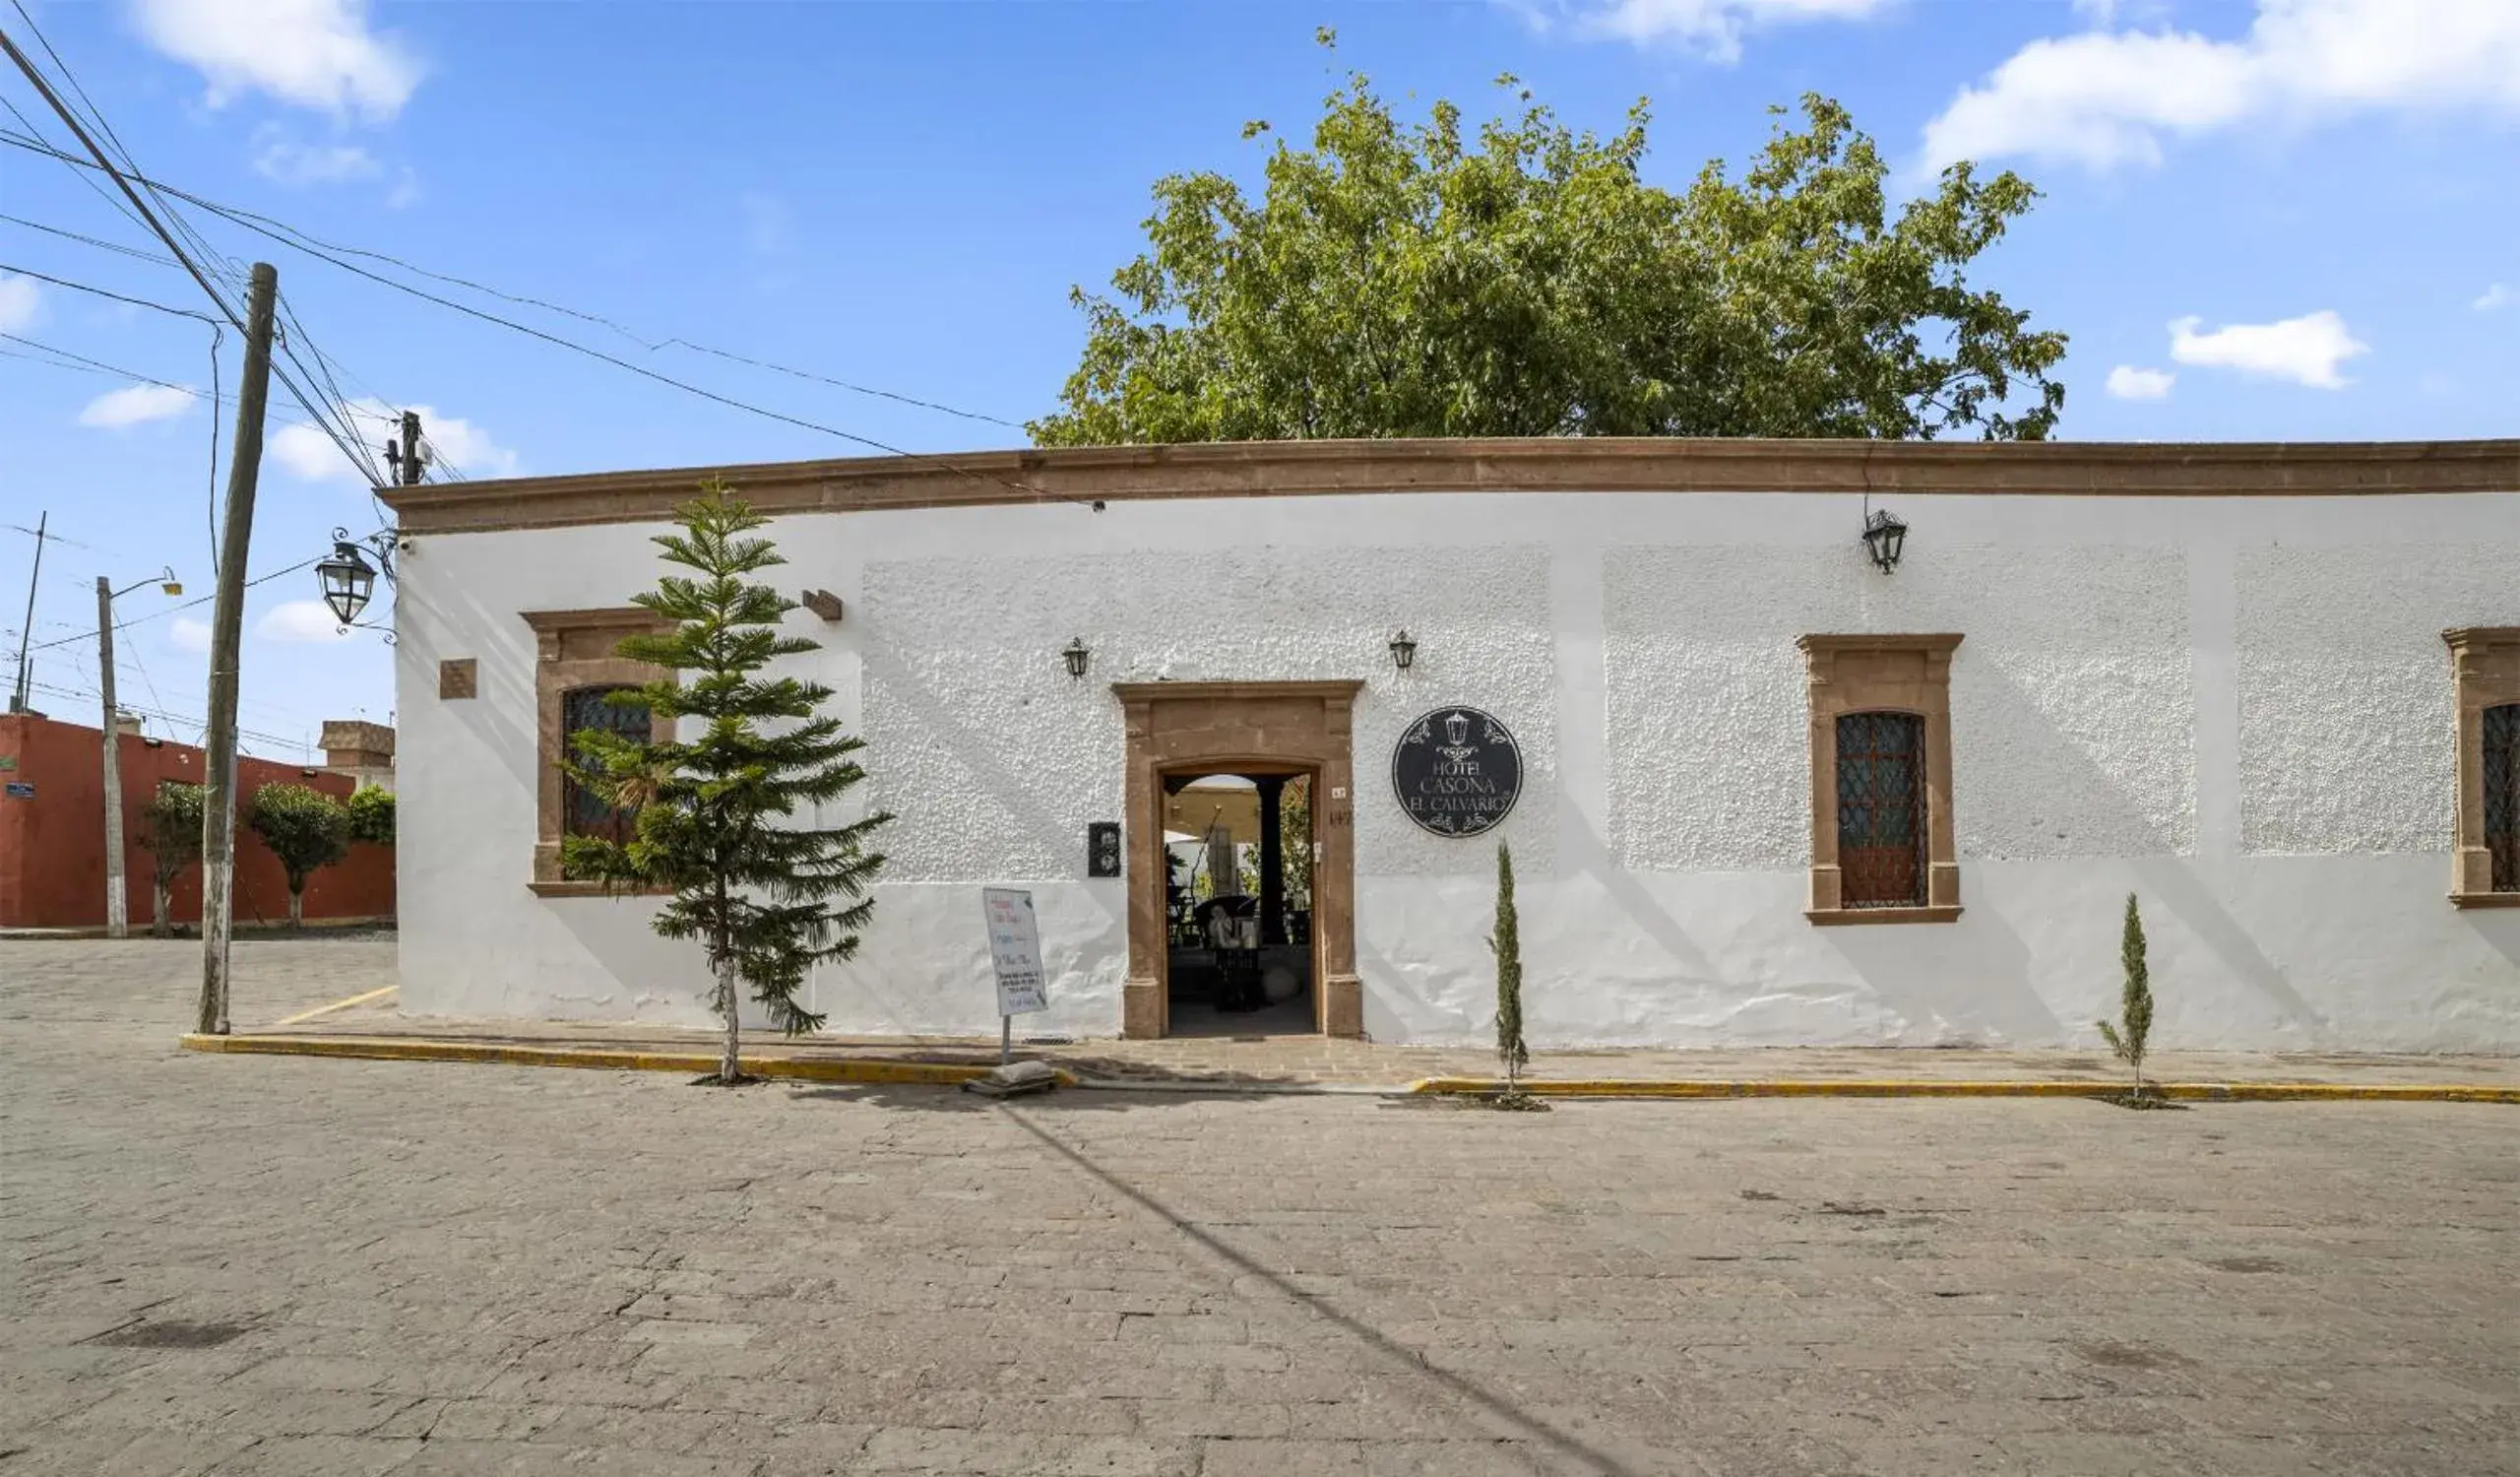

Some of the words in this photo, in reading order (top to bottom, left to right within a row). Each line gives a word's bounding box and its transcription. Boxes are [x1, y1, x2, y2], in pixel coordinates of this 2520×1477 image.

[1433, 761, 1480, 776] HOTEL
[1419, 777, 1496, 795] CASONA
[1411, 797, 1424, 810] EL
[1430, 797, 1506, 811] CALVARIO
